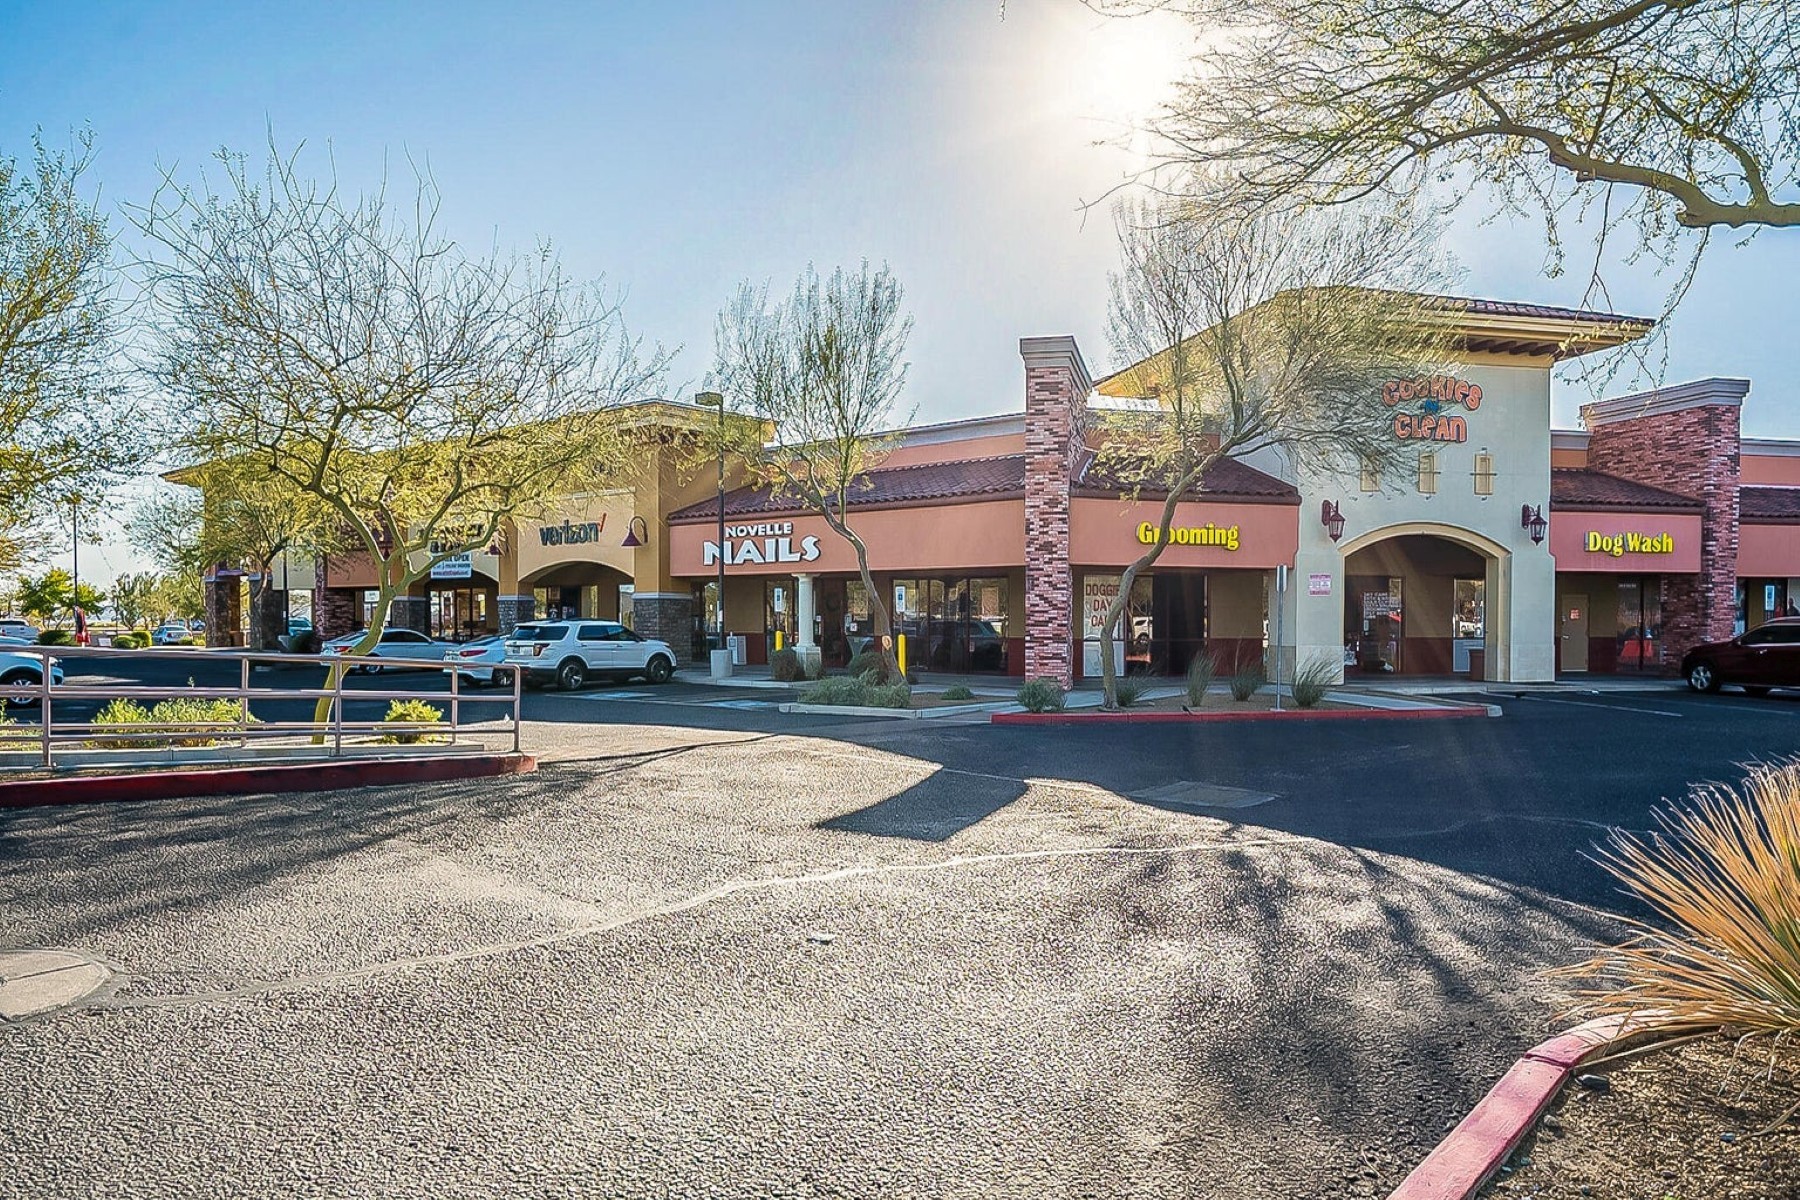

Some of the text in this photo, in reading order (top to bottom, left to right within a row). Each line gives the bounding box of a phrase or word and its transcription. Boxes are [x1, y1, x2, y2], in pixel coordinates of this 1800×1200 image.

[540, 519, 599, 546] verizon
[725, 522, 793, 538] NOVELLE
[1138, 521, 1239, 551] Grooming
[703, 535, 821, 566] NAILS
[1587, 531, 1674, 557] Dog Wash
